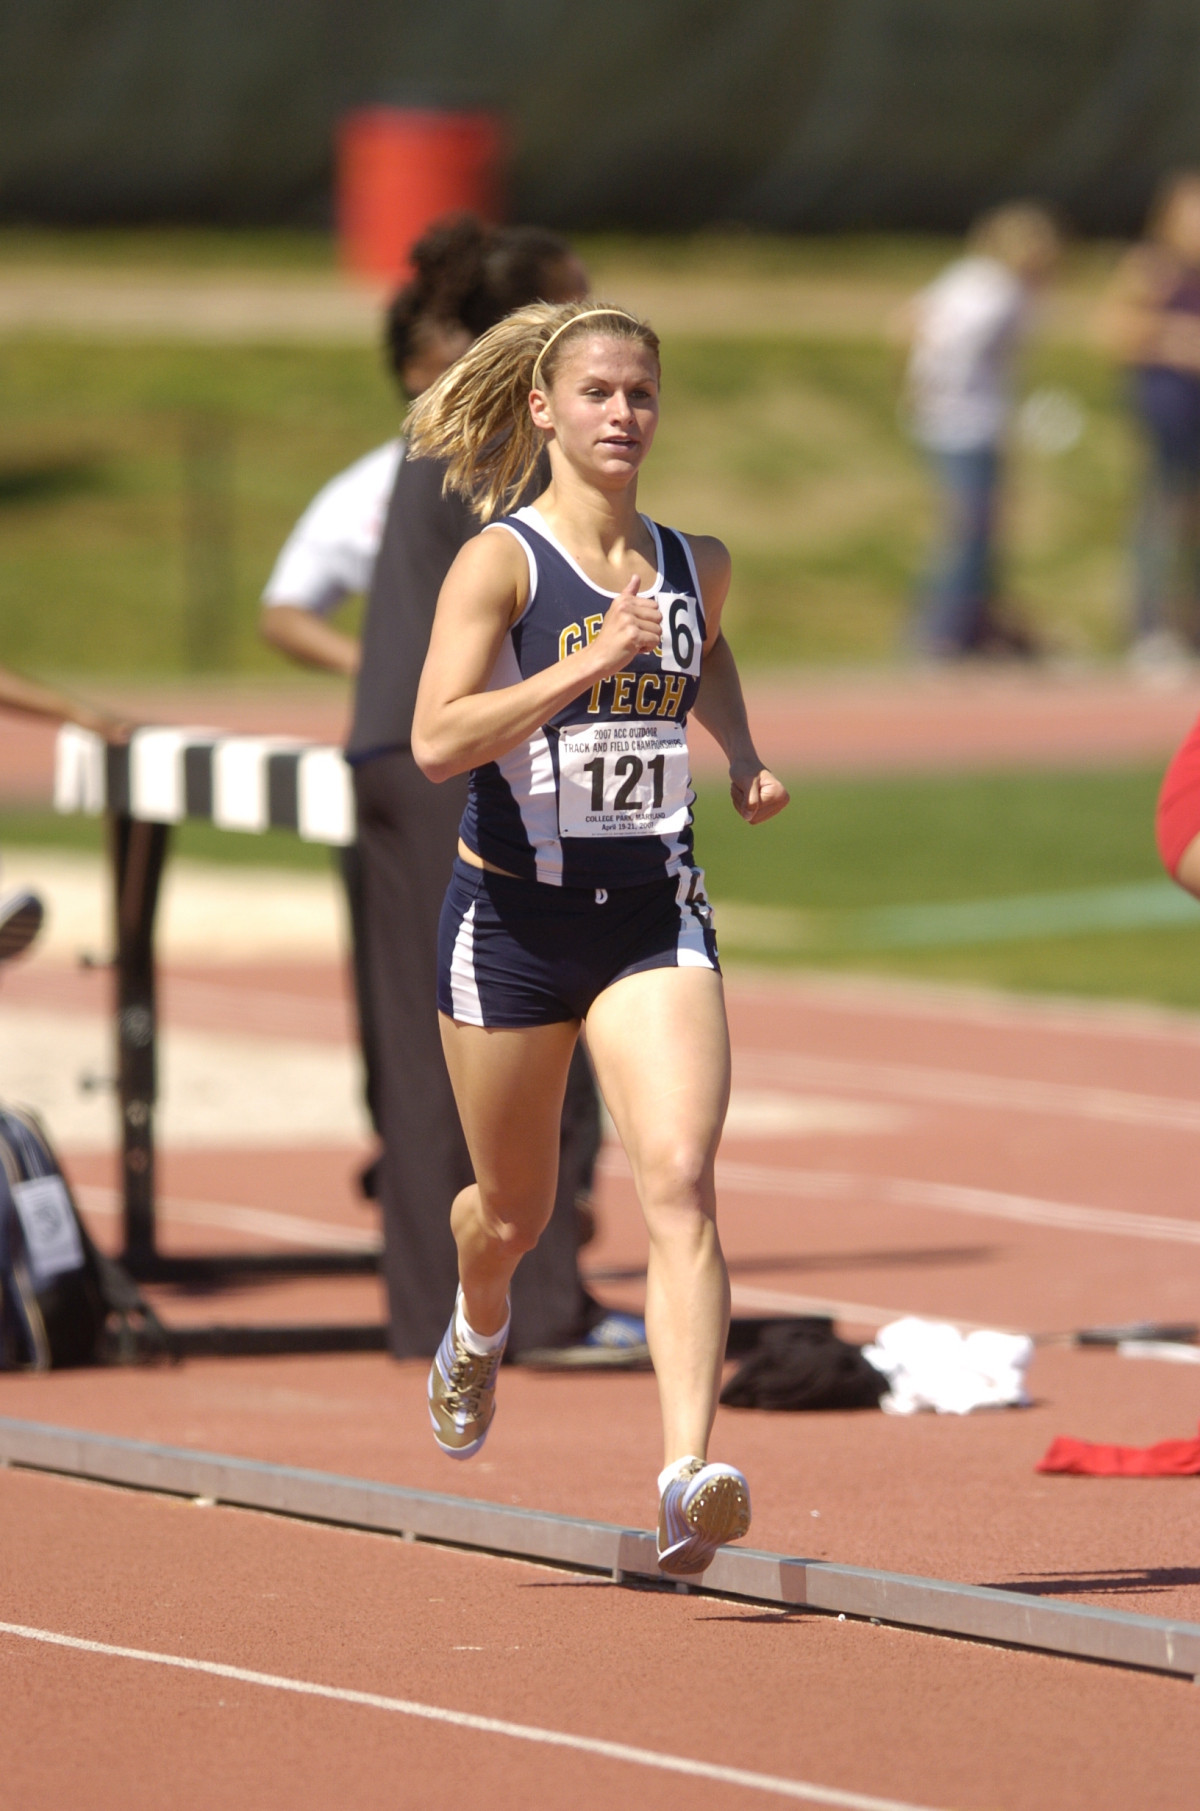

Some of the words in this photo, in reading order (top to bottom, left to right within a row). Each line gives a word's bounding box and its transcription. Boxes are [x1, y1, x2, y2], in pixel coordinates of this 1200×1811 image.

[669, 599, 694, 669] 6
[587, 672, 687, 717] TECH
[594, 729, 611, 740] 2007
[613, 728, 627, 739] ACC
[629, 727, 658, 739] OUTDOOR
[564, 743, 590, 753] TRACK
[592, 742, 608, 752] AND
[610, 741, 630, 752] FIELD
[631, 739, 683, 751] CHAMPIONSHIPS
[583, 754, 665, 811] 121
[585, 815, 613, 823] COLLEGE
[601, 823, 617, 832] April
